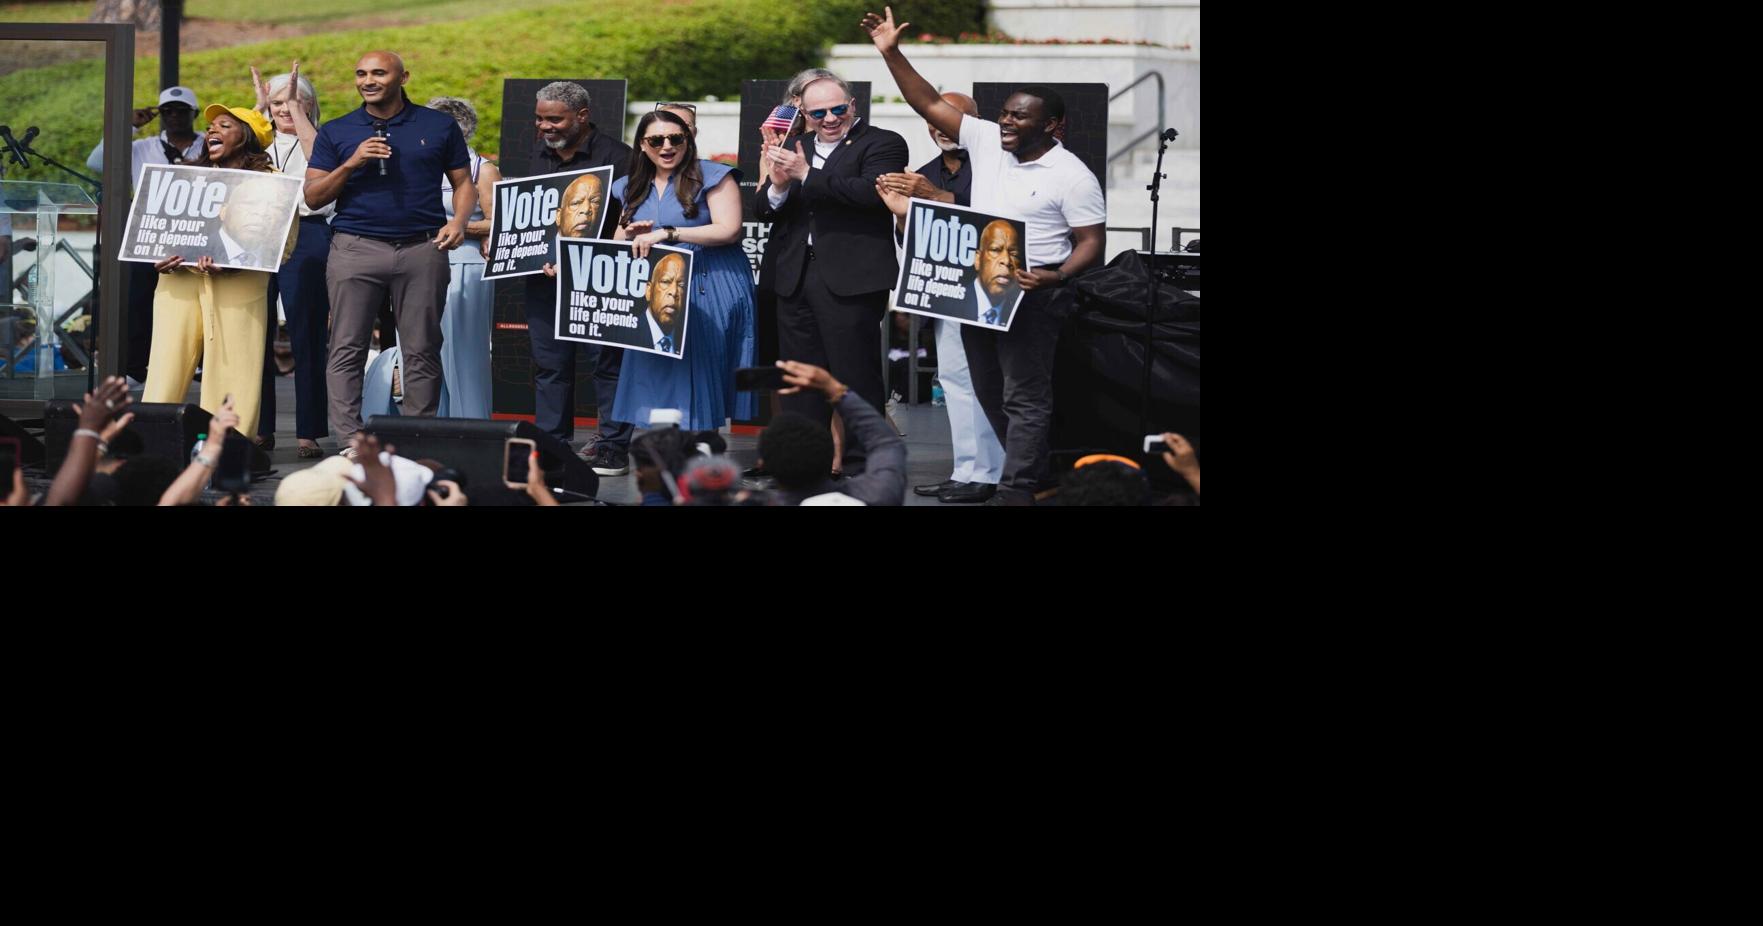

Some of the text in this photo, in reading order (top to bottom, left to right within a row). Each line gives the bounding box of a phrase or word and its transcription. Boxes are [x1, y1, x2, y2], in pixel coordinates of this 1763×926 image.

[145, 170, 227, 219] Vote
[501, 184, 560, 232] Vote
[140, 215, 205, 233] like your
[136, 230, 208, 247] life depends
[497, 229, 546, 247] like your
[914, 206, 978, 267] Vote
[134, 243, 167, 257] on it.
[495, 241, 549, 261] life depends
[492, 259, 517, 273] on it.
[567, 244, 650, 298] Vote
[910, 258, 964, 282] like your
[906, 274, 967, 300] life depends
[570, 291, 635, 312] like your
[904, 292, 931, 309] on it.
[569, 306, 638, 329] life depends
[569, 322, 602, 337] on it.
